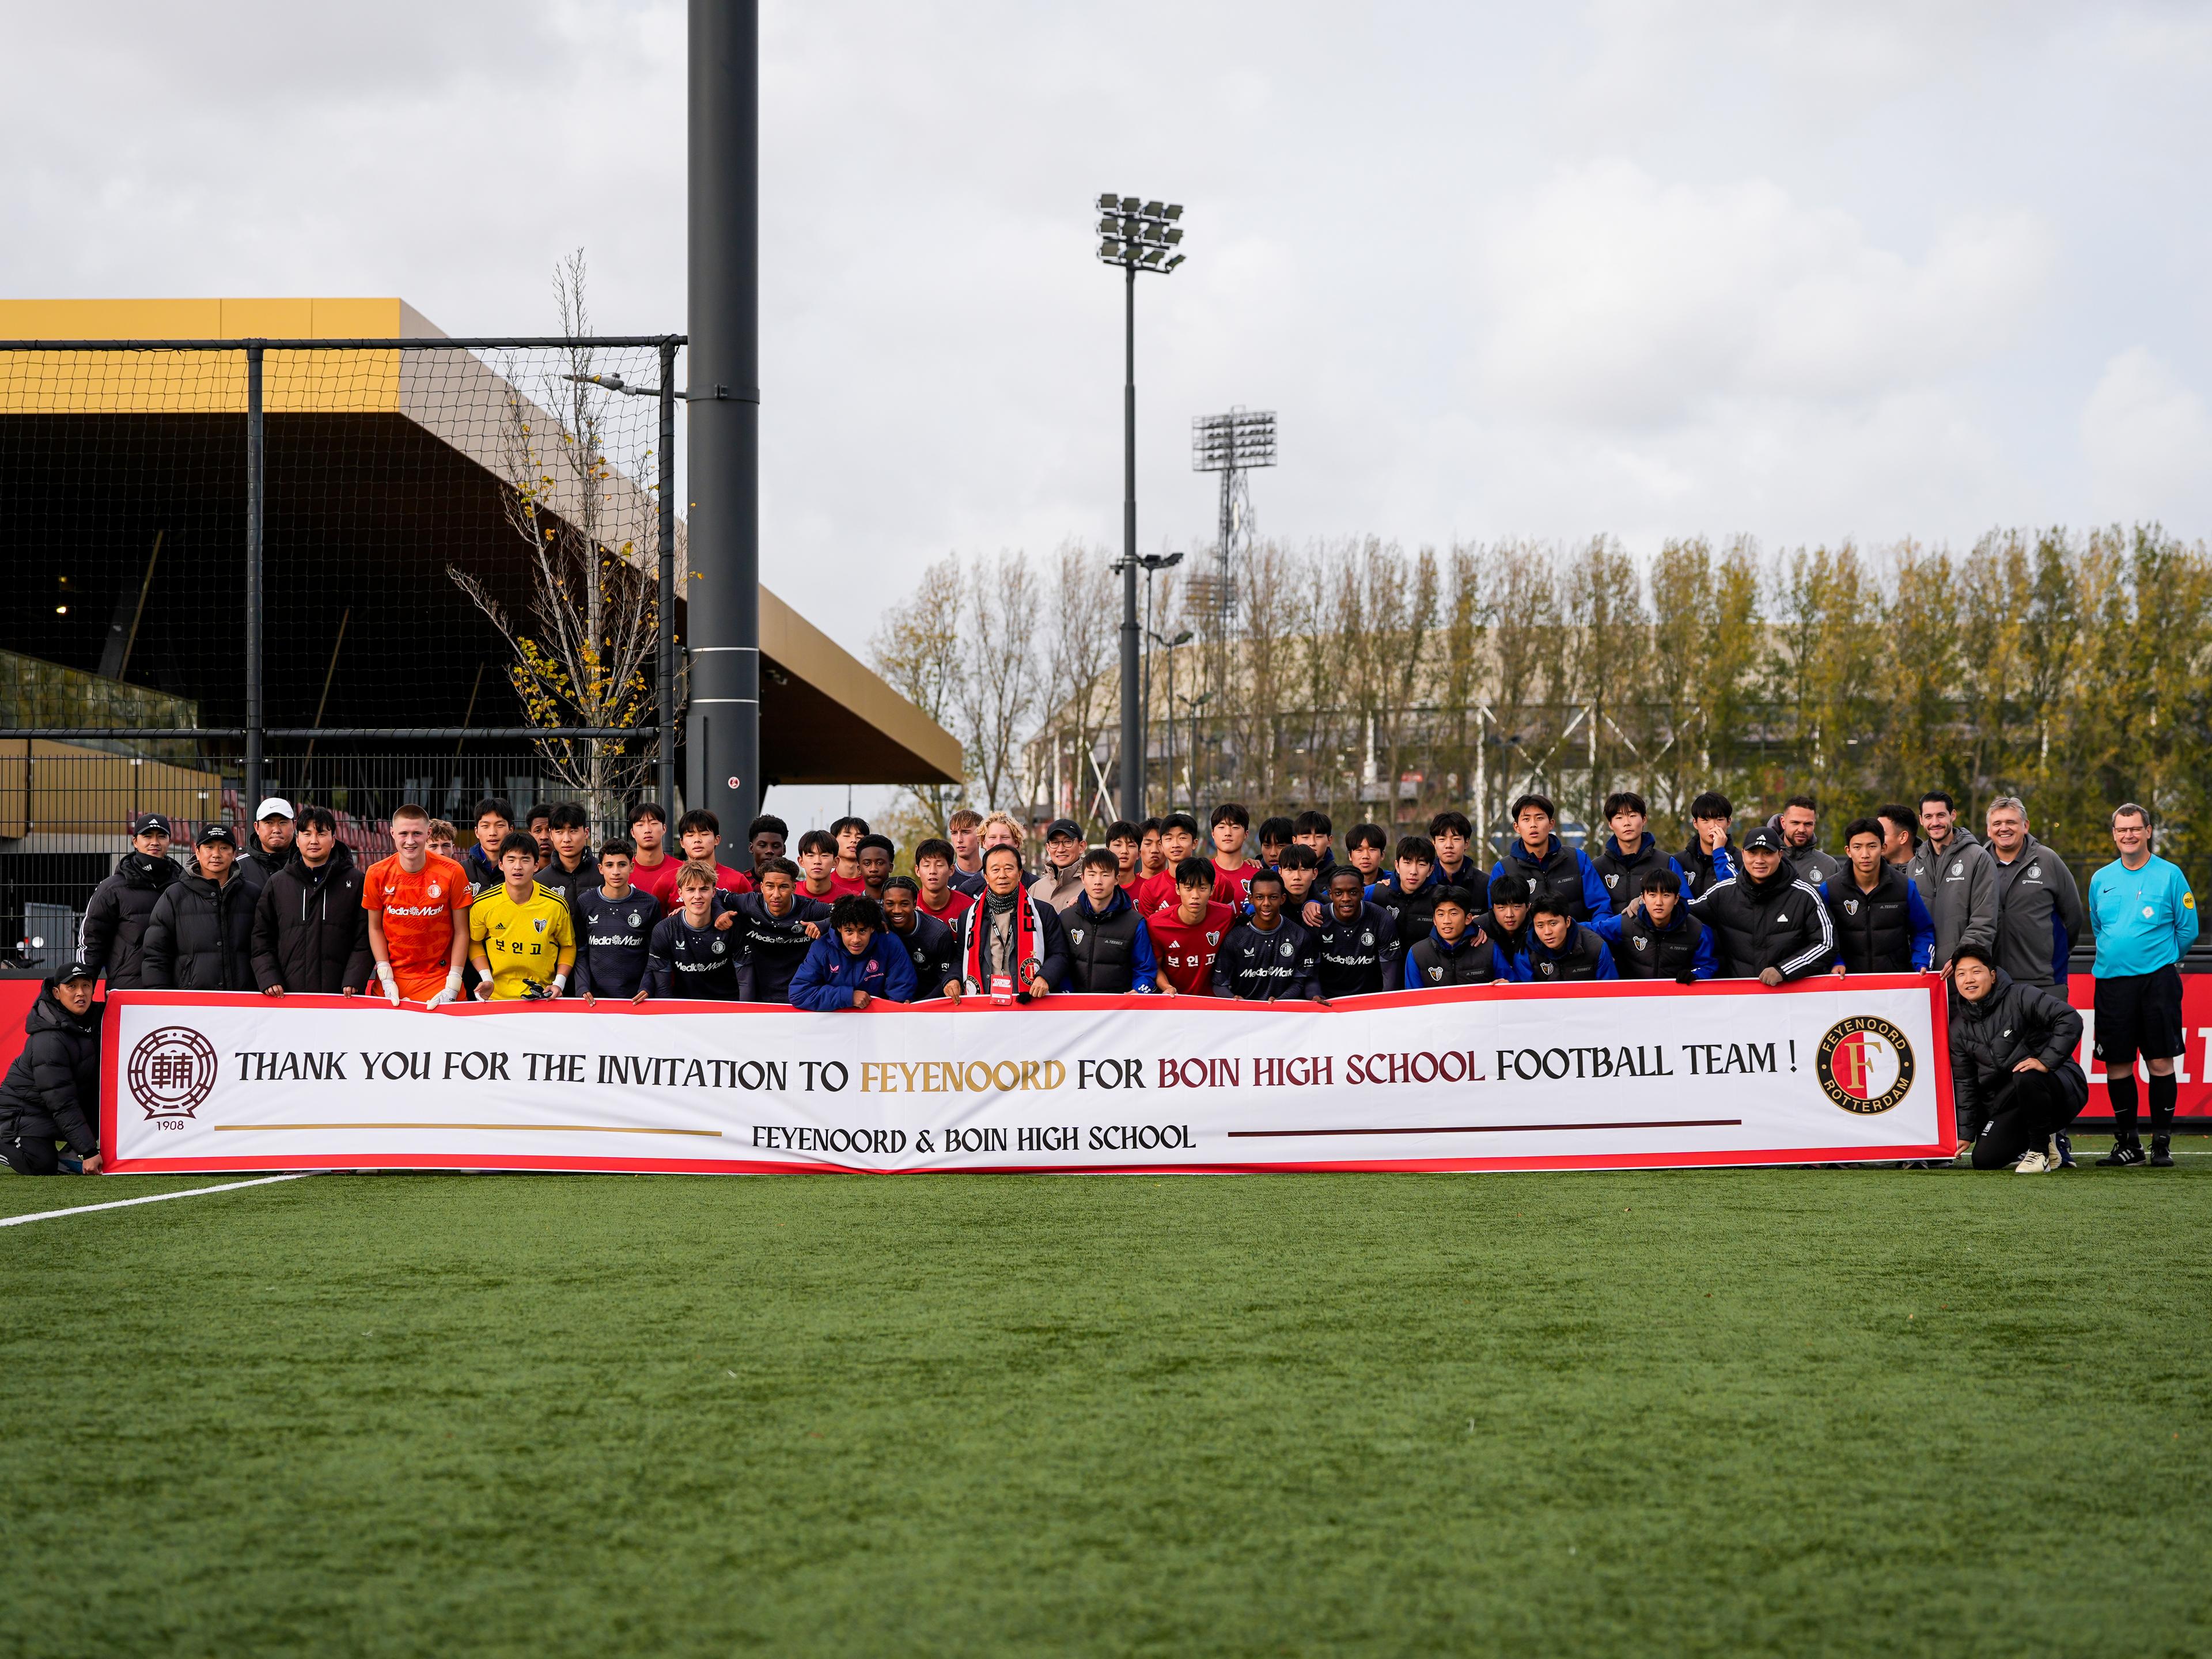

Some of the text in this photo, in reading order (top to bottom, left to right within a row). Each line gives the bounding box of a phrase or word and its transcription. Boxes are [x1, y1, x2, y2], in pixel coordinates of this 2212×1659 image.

[496, 939, 541, 955] 보인고
[1168, 953, 1216, 967] 보인고
[1822, 1018, 1907, 1052] FEYENOORD
[235, 1052, 348, 1081] THANK
[359, 1051, 430, 1080] YOU
[442, 1051, 511, 1081] FOR
[523, 1053, 586, 1083] THE
[597, 1055, 787, 1091] INVITATION
[799, 1061, 849, 1092] TO
[860, 1060, 1066, 1093] FEYENOORD
[1078, 1059, 1146, 1089] FOR
[1158, 1058, 1240, 1088] BOIN
[1253, 1056, 1334, 1086] HIGH
[1346, 1051, 1486, 1085] SCHOOL
[1496, 1046, 1673, 1081] FOOTBALL
[1682, 1043, 1778, 1075] TEAM
[1824, 1077, 1910, 1112] ROTTERDAM
[156, 1120, 184, 1131] 1908
[752, 1125, 1196, 1154] FEYENOORD & BOIN HIGH SCHOOL
